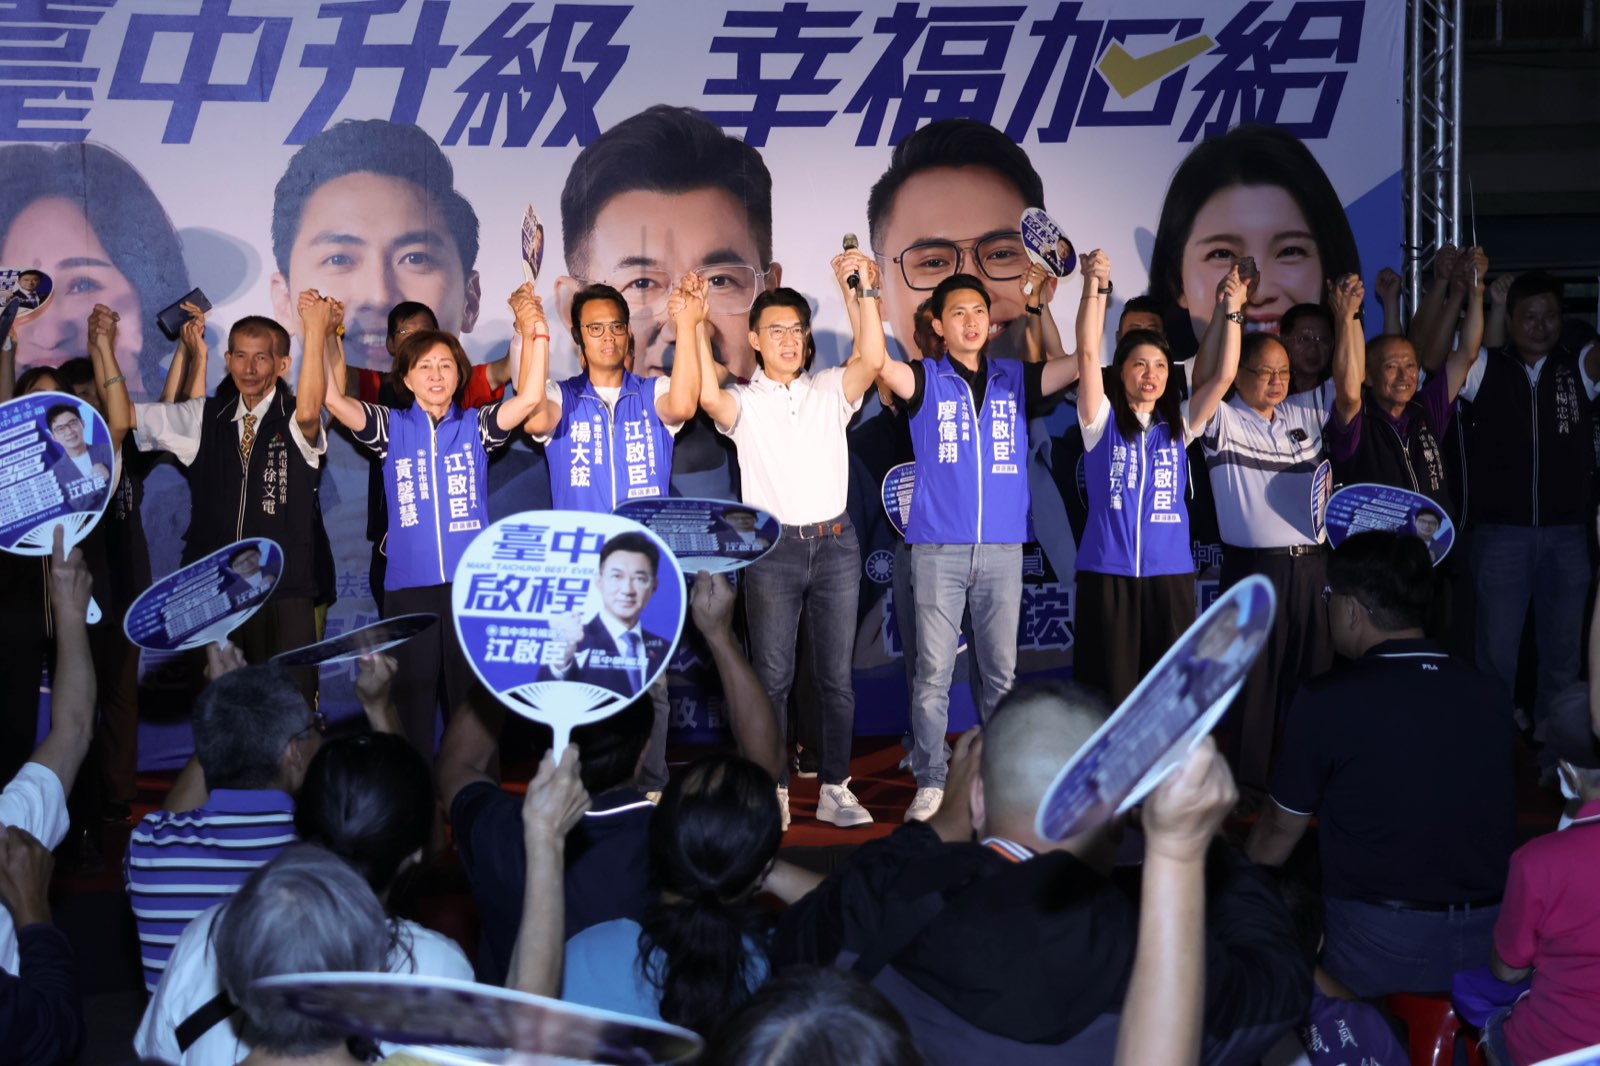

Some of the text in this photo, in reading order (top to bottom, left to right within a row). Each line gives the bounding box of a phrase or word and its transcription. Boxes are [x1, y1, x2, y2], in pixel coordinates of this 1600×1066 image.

[701, 0, 1367, 147] 幸福加給
[624, 419, 649, 486] 江啟臣
[937, 400, 958, 464] 廖偉翔
[961, 402, 970, 441] 立法委員
[990, 399, 1011, 462] 江啟臣
[444, 452, 469, 519] 江啟臣
[570, 420, 591, 488] 楊大鋐
[1153, 448, 1172, 511] 江啟臣
[262, 467, 277, 515] 徐文電
[395, 457, 419, 528] 黃馨慧
[466, 561, 492, 570] MAKE
[496, 563, 542, 573] TAICHUNG
[545, 565, 568, 574] BEST
[491, 523, 606, 564] 臺中
[463, 572, 591, 615] 啟程
[485, 637, 568, 665] 江啟臣
